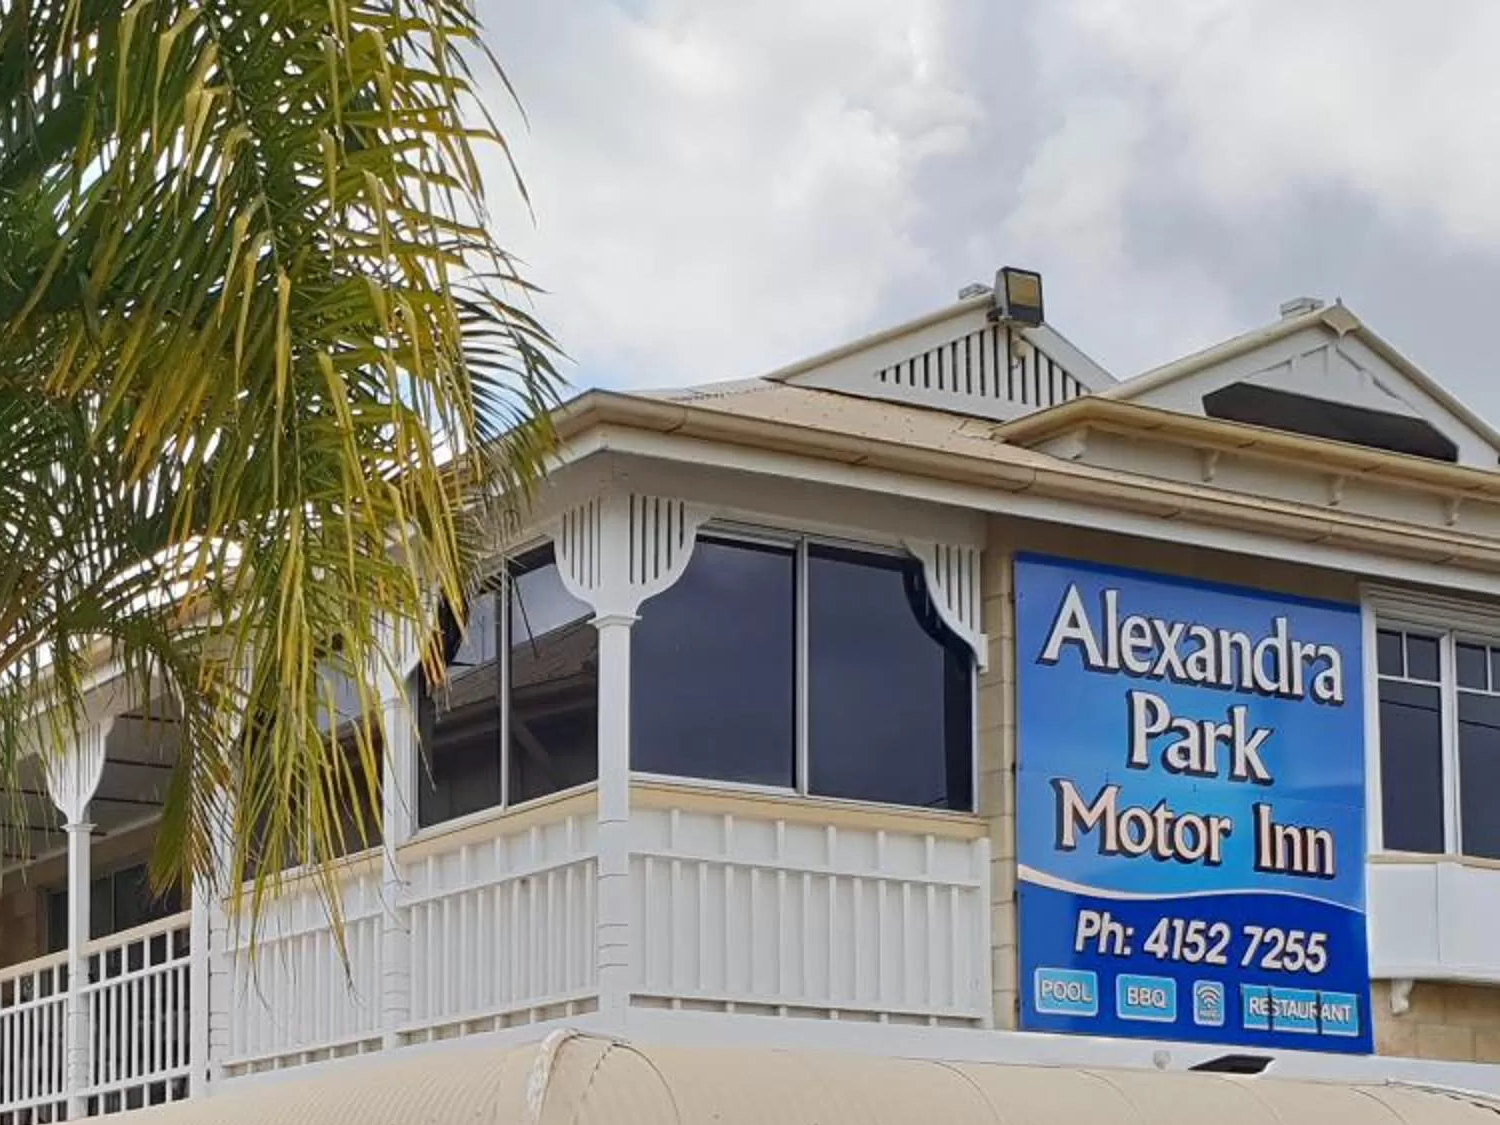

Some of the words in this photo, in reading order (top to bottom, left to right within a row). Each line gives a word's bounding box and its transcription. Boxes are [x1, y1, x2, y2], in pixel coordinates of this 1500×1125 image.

[1039, 583, 1344, 702] Alexandra
[1130, 690, 1273, 783] Park
[1058, 780, 1232, 863] Motor
[1256, 803, 1336, 875] Inn
[1075, 910, 1133, 956] Ph:
[1143, 917, 1231, 965] 4152
[1241, 925, 1329, 973] 7255
[1040, 979, 1093, 1003] POOL
[1126, 986, 1168, 1009] BBQ
[1248, 996, 1352, 1022] RESTAURANT
